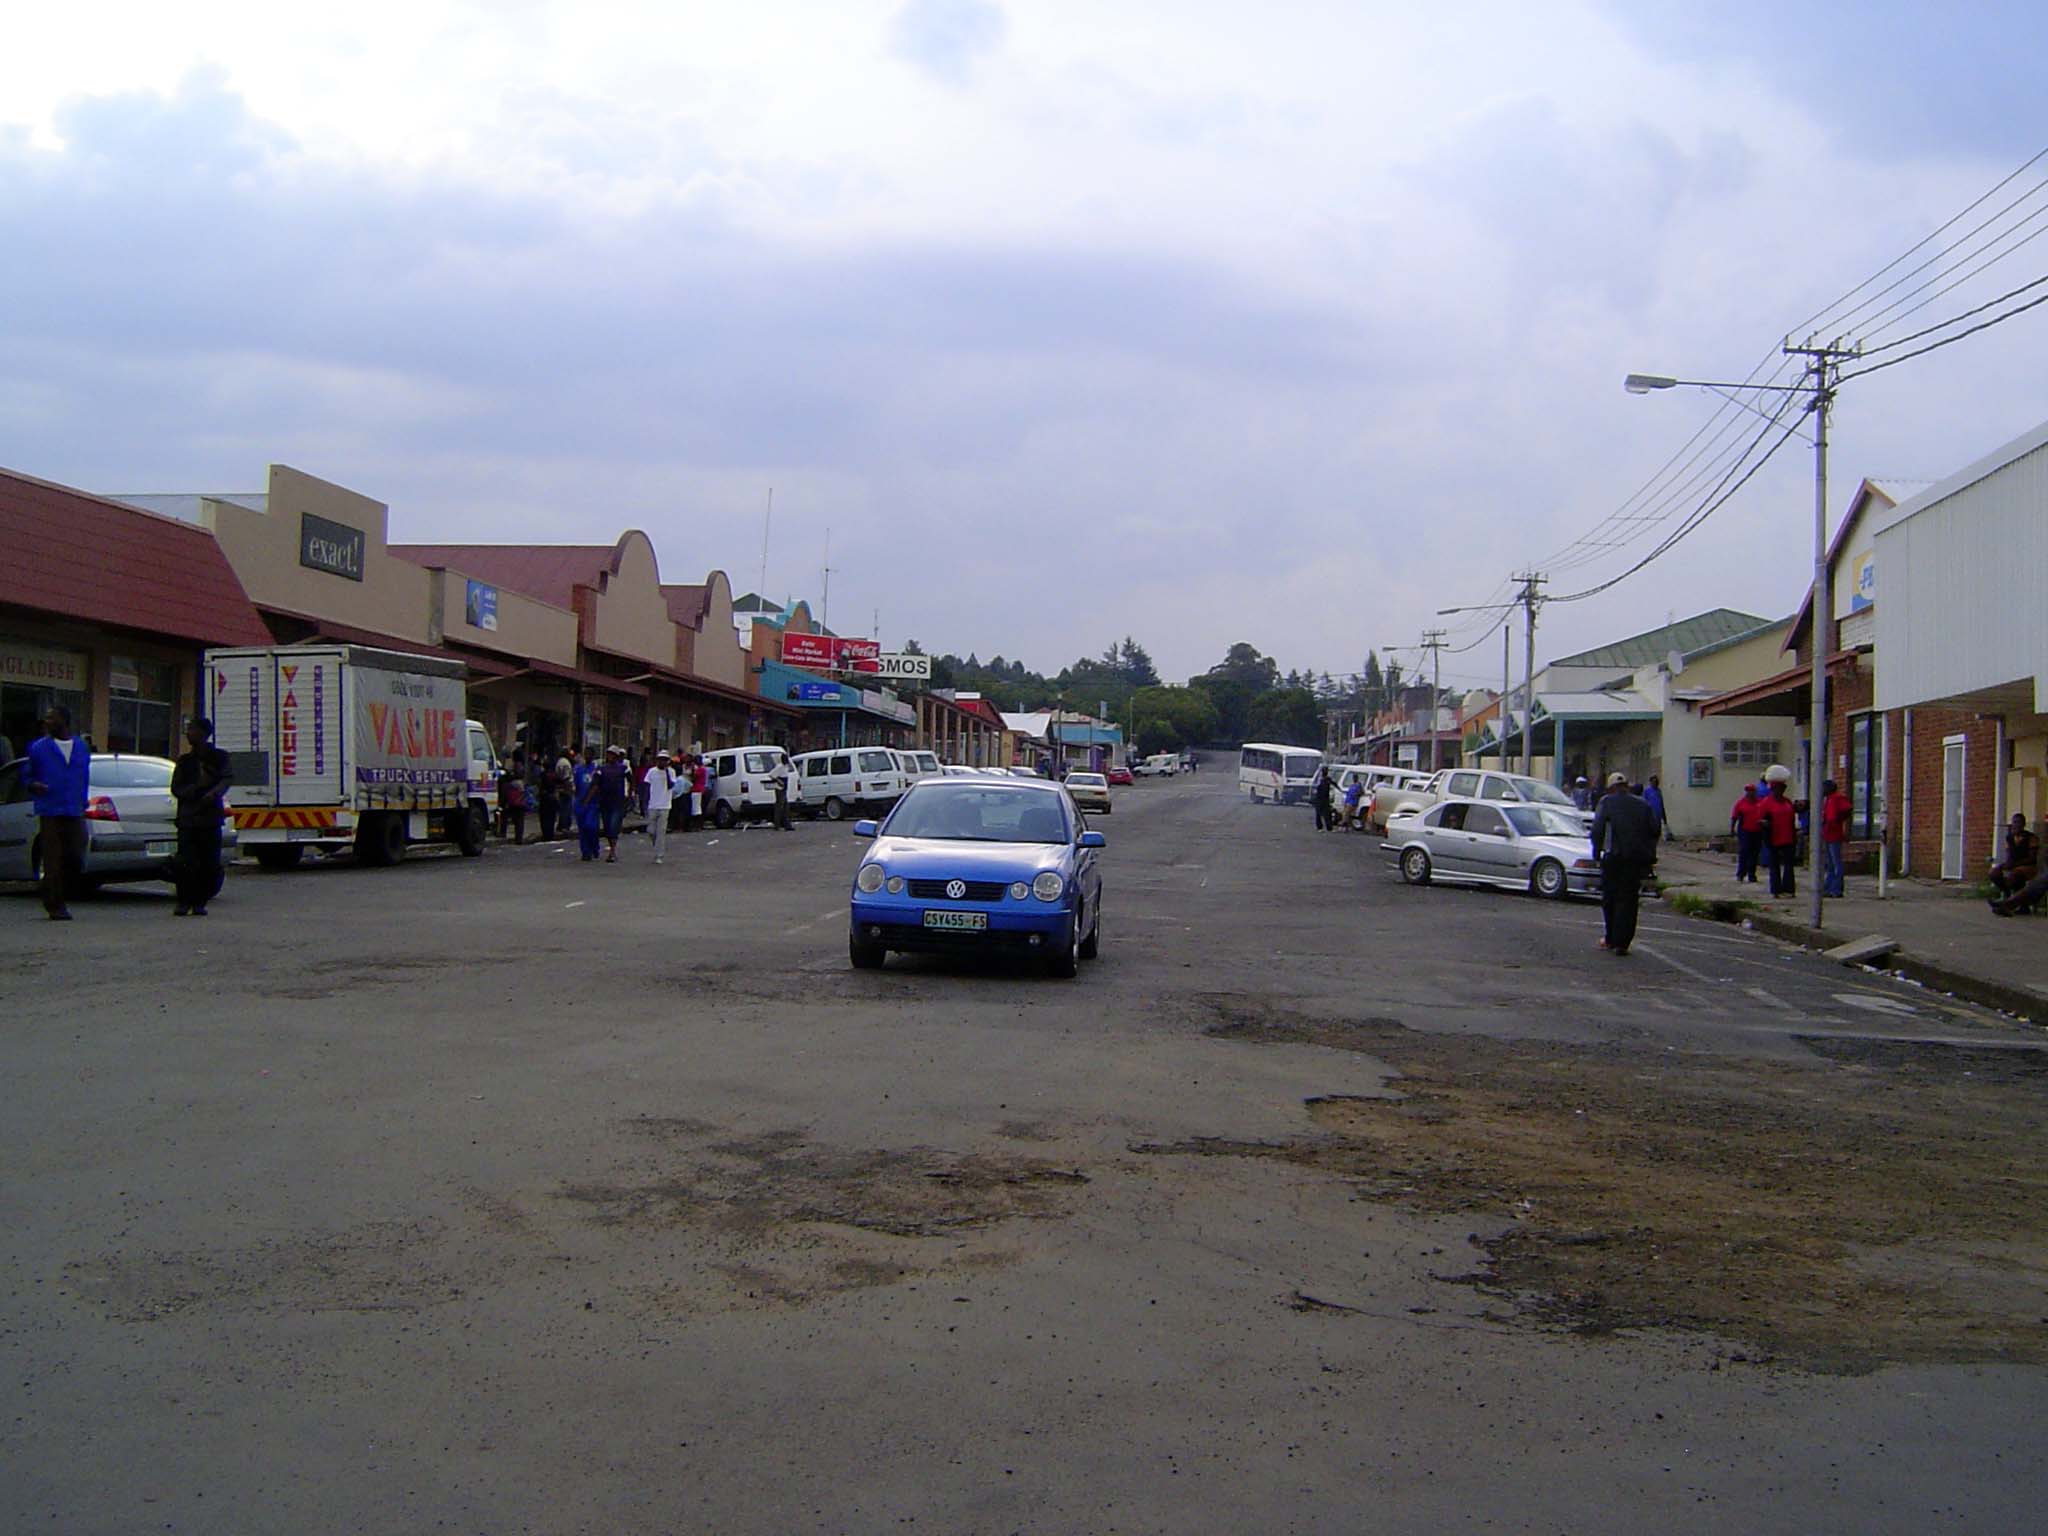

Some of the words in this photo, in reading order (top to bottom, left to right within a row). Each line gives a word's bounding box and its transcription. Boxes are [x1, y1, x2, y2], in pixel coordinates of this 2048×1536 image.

[309, 536, 359, 573] exact!
[367, 702, 457, 759] VALUE
[371, 768, 411, 782] TRUCK
[415, 769, 456, 783] RENTAL
